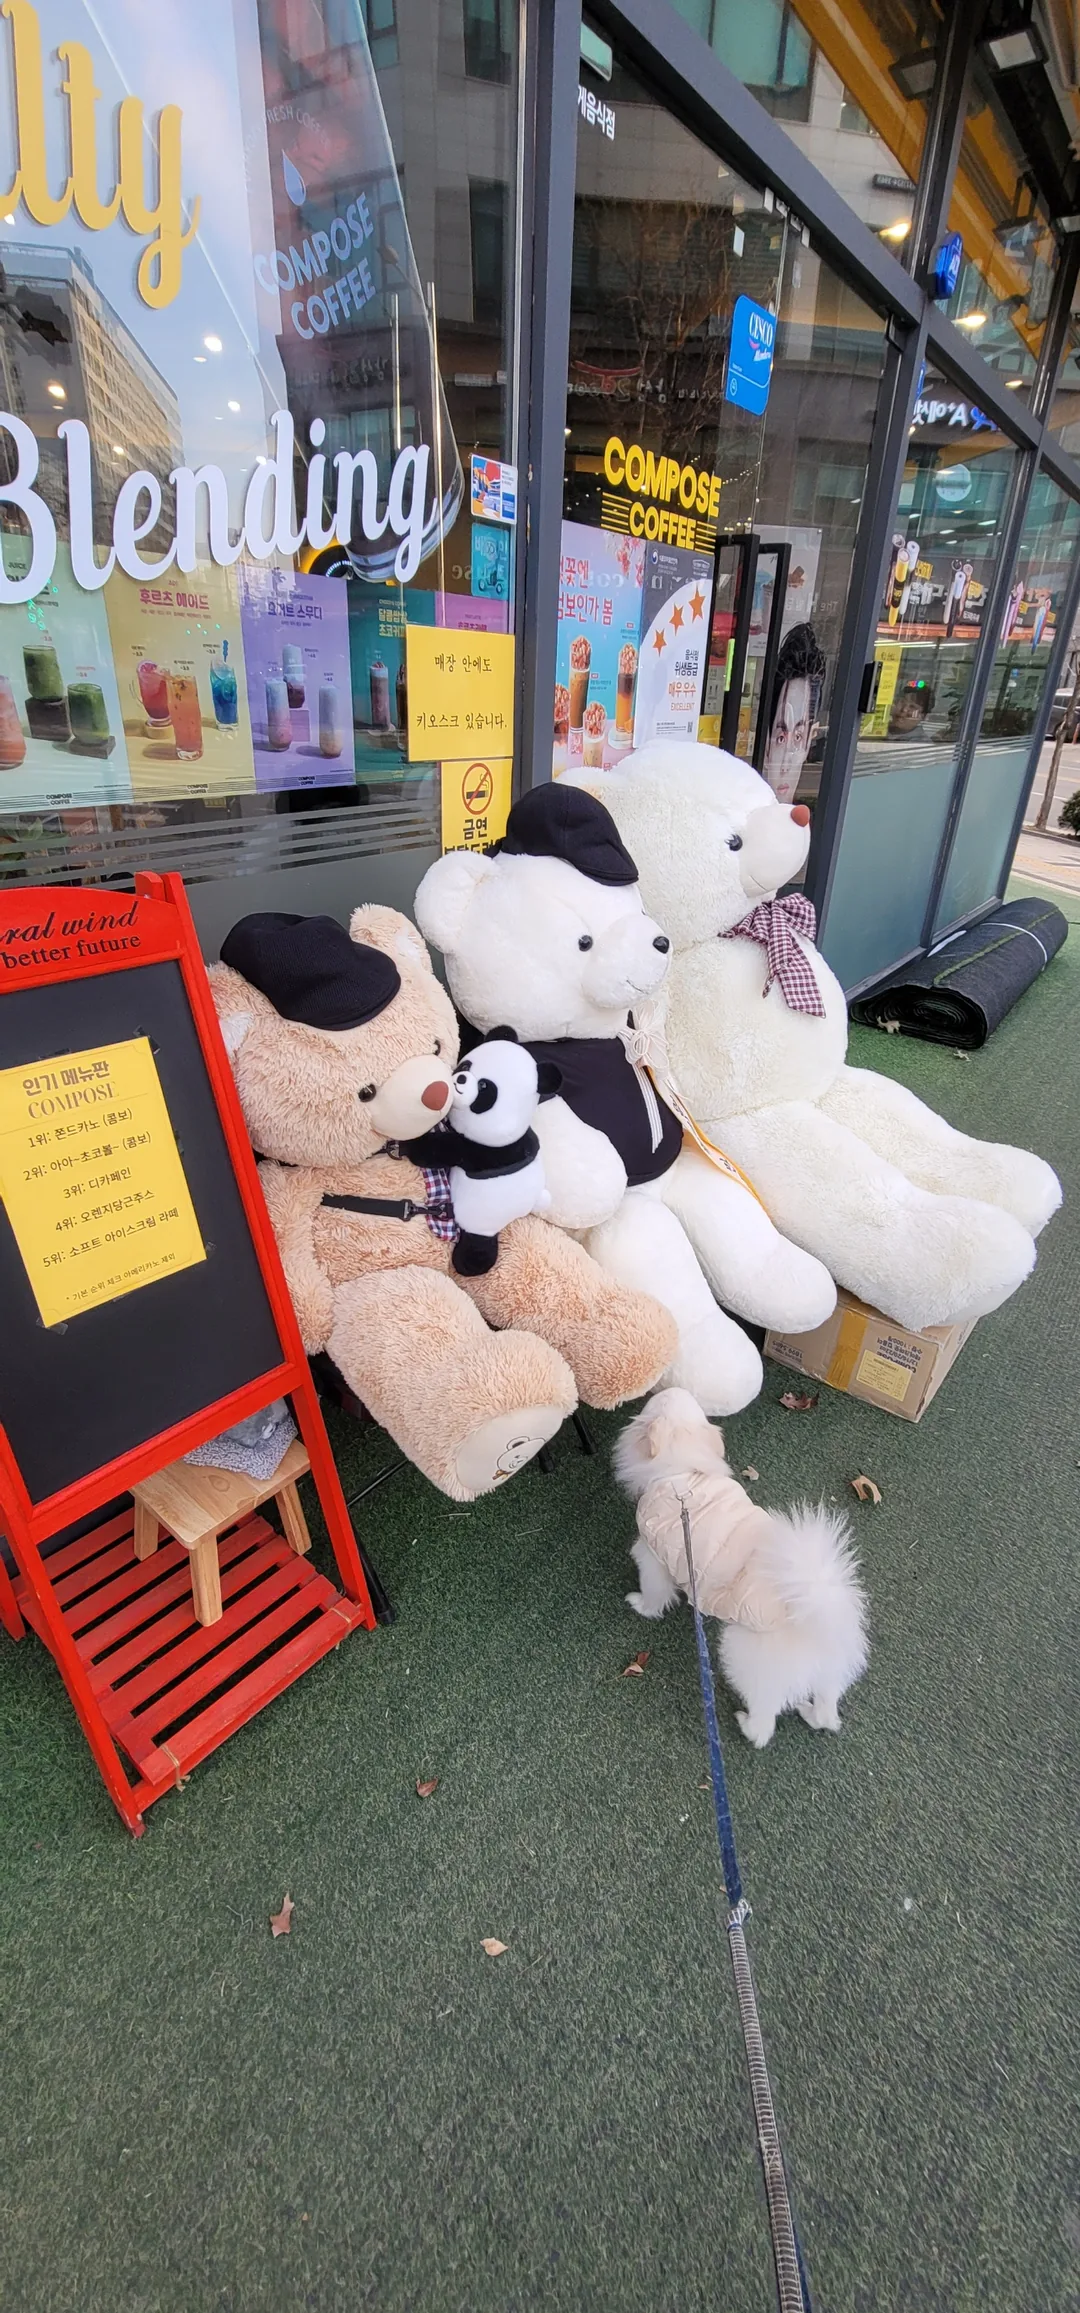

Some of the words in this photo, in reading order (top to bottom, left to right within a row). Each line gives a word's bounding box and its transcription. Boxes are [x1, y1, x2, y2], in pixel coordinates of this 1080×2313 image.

[253, 191, 374, 295] COMPOSE
[291, 256, 376, 340] COFFEE
[749, 312, 774, 348] CESCO
[604, 436, 721, 518] COMPOSE
[0, 409, 437, 605] Blending
[629, 501, 697, 551] COFFEE
[139, 588, 174, 607] 후르츠
[176, 592, 209, 610] 에이드
[297, 604, 323, 621] 스무디
[602, 597, 613, 626] 봄
[434, 653, 456, 673] 매장
[462, 654, 492, 674] 안에도
[675, 661, 699, 676] 위생등급
[416, 712, 460, 729] 키오스크
[465, 711, 508, 730] 있습니다.
[463, 817, 487, 840] 금연
[61, 900, 139, 936] wind
[0, 946, 71, 969] better
[76, 935, 141, 957] future
[22, 1073, 59, 1097] 인기
[60, 1060, 110, 1086] 메뉴판
[28, 1081, 120, 1119] COMPOSE
[28, 1132, 51, 1148] 1위:
[102, 1107, 132, 1127] (콤보)
[23, 1164, 47, 1181] 2위:
[122, 1131, 151, 1150] (콤보)
[63, 1182, 86, 1199] 3위:
[88, 1167, 132, 1189] 디카페인
[55, 1215, 78, 1232] 4위:
[80, 1189, 155, 1223] 오렌지당근주스
[42, 1250, 66, 1268] 5위:
[69, 1237, 103, 1258] 소프트
[104, 1215, 157, 1243] 아이스크림
[159, 1207, 180, 1222] 라떼
[72, 1289, 89, 1301] 기본
[90, 1282, 106, 1294] 순위
[123, 1261, 160, 1279] 아메리카노
